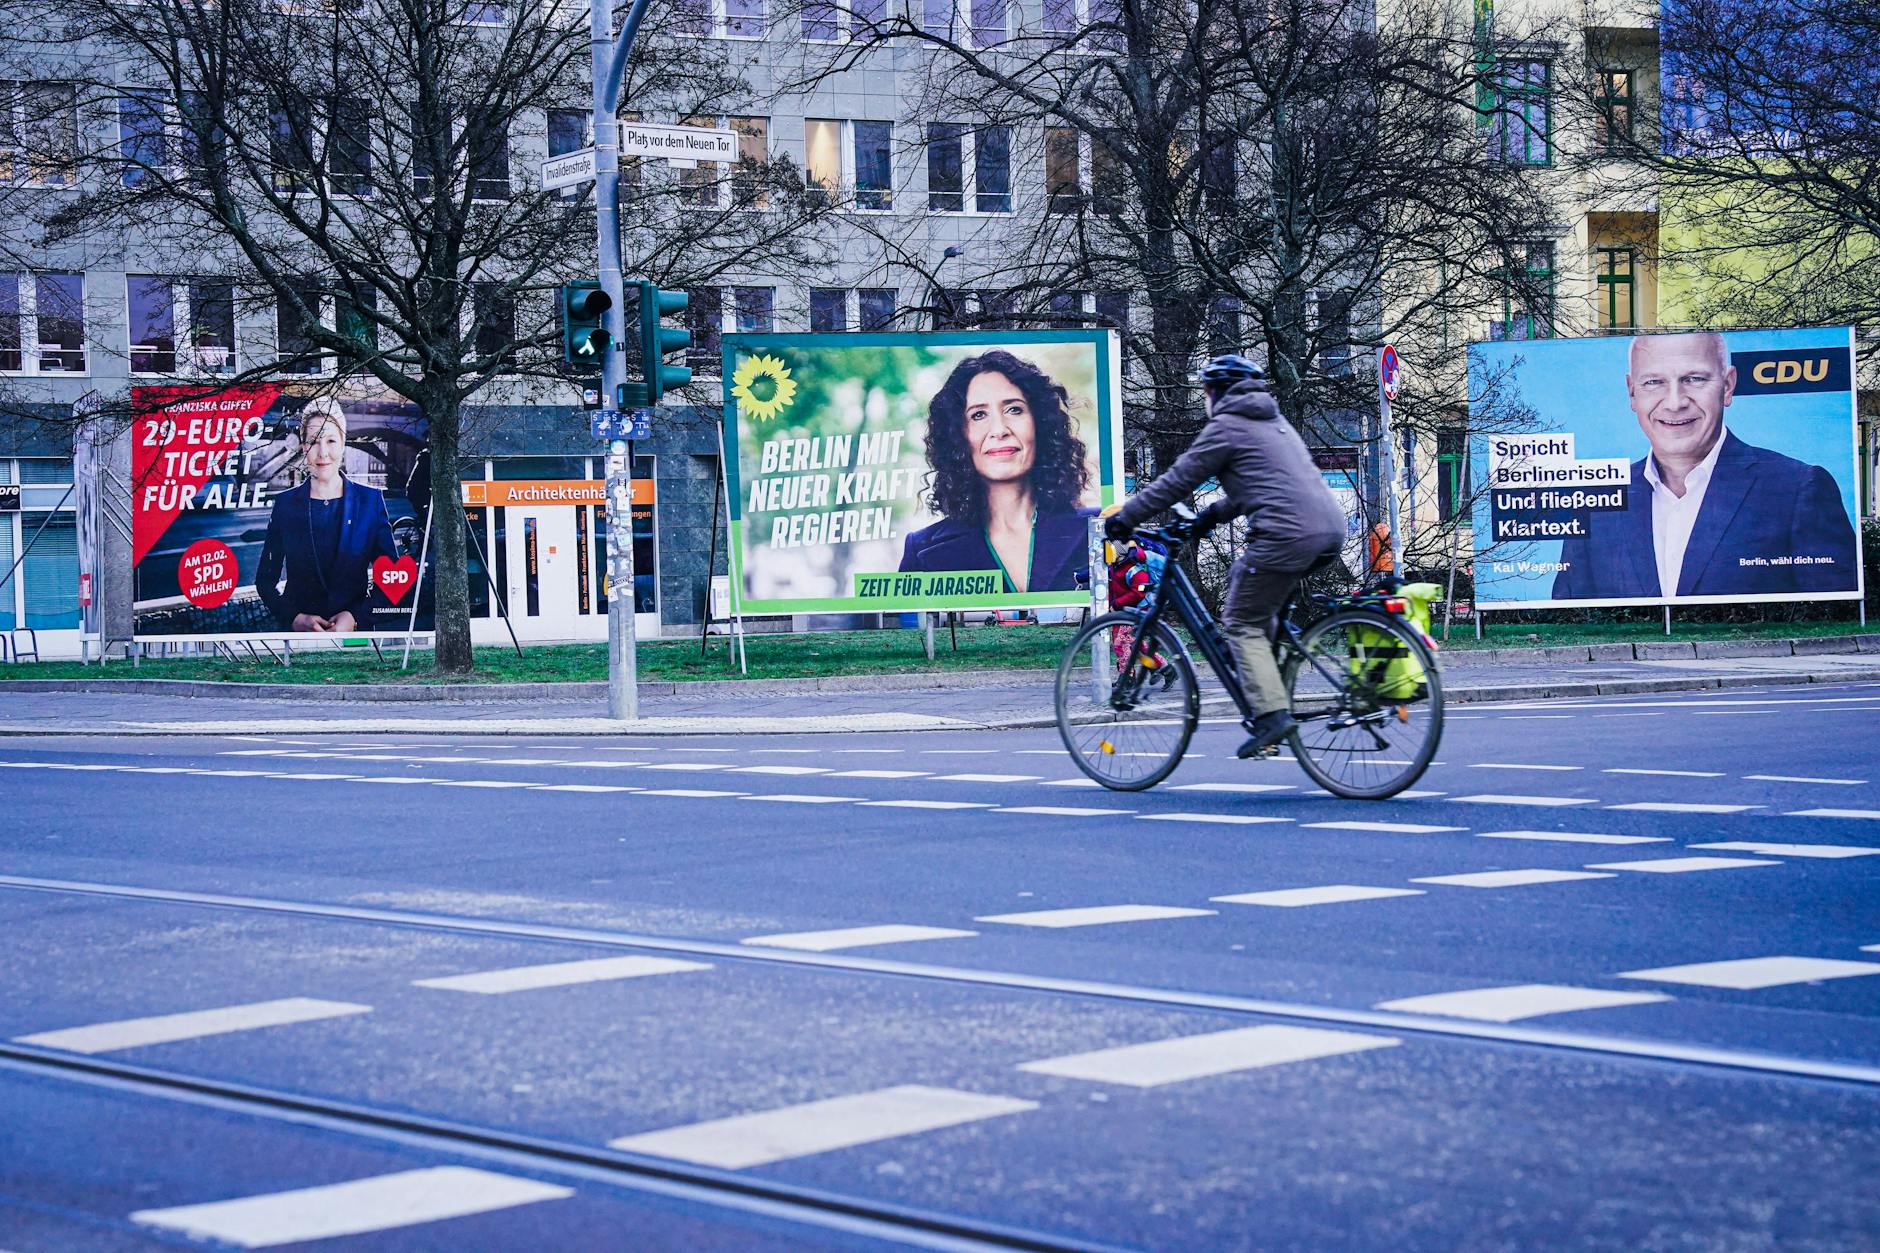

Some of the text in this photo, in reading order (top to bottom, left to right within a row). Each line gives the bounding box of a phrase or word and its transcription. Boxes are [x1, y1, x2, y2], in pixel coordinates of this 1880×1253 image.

[650, 136, 663, 147] vor
[665, 134, 684, 148] dem
[686, 135, 715, 151] Neuen
[716, 137, 730, 151] Tor
[546, 156, 591, 181] Invalidenstraße
[1752, 359, 1829, 384] CDU
[220, 400, 253, 411] GIFFEY
[142, 416, 274, 447] 29-EURO-
[760, 430, 905, 474] BERLIN MIT
[1495, 439, 1569, 460] Spricht
[164, 449, 257, 478] TICKET
[1497, 464, 1625, 483] Berlinerisch.
[142, 479, 273, 512] FÜR ALLE.
[748, 467, 919, 513] NEUER KRAFT
[1497, 489, 1623, 510] Und fließend
[770, 506, 897, 549] REGIEREN.
[1498, 518, 1586, 537] Klartext.
[184, 549, 228, 569] AM 12.02.
[1493, 561, 1571, 574] Kai Wegner
[1739, 555, 1835, 567] Berlin, wähl dich neu.
[193, 562, 224, 585] SPD
[382, 570, 409, 584] SPD
[189, 578, 233, 598] WÄHLEN!
[859, 574, 998, 598] ZEIT FÜR JARASCH.
